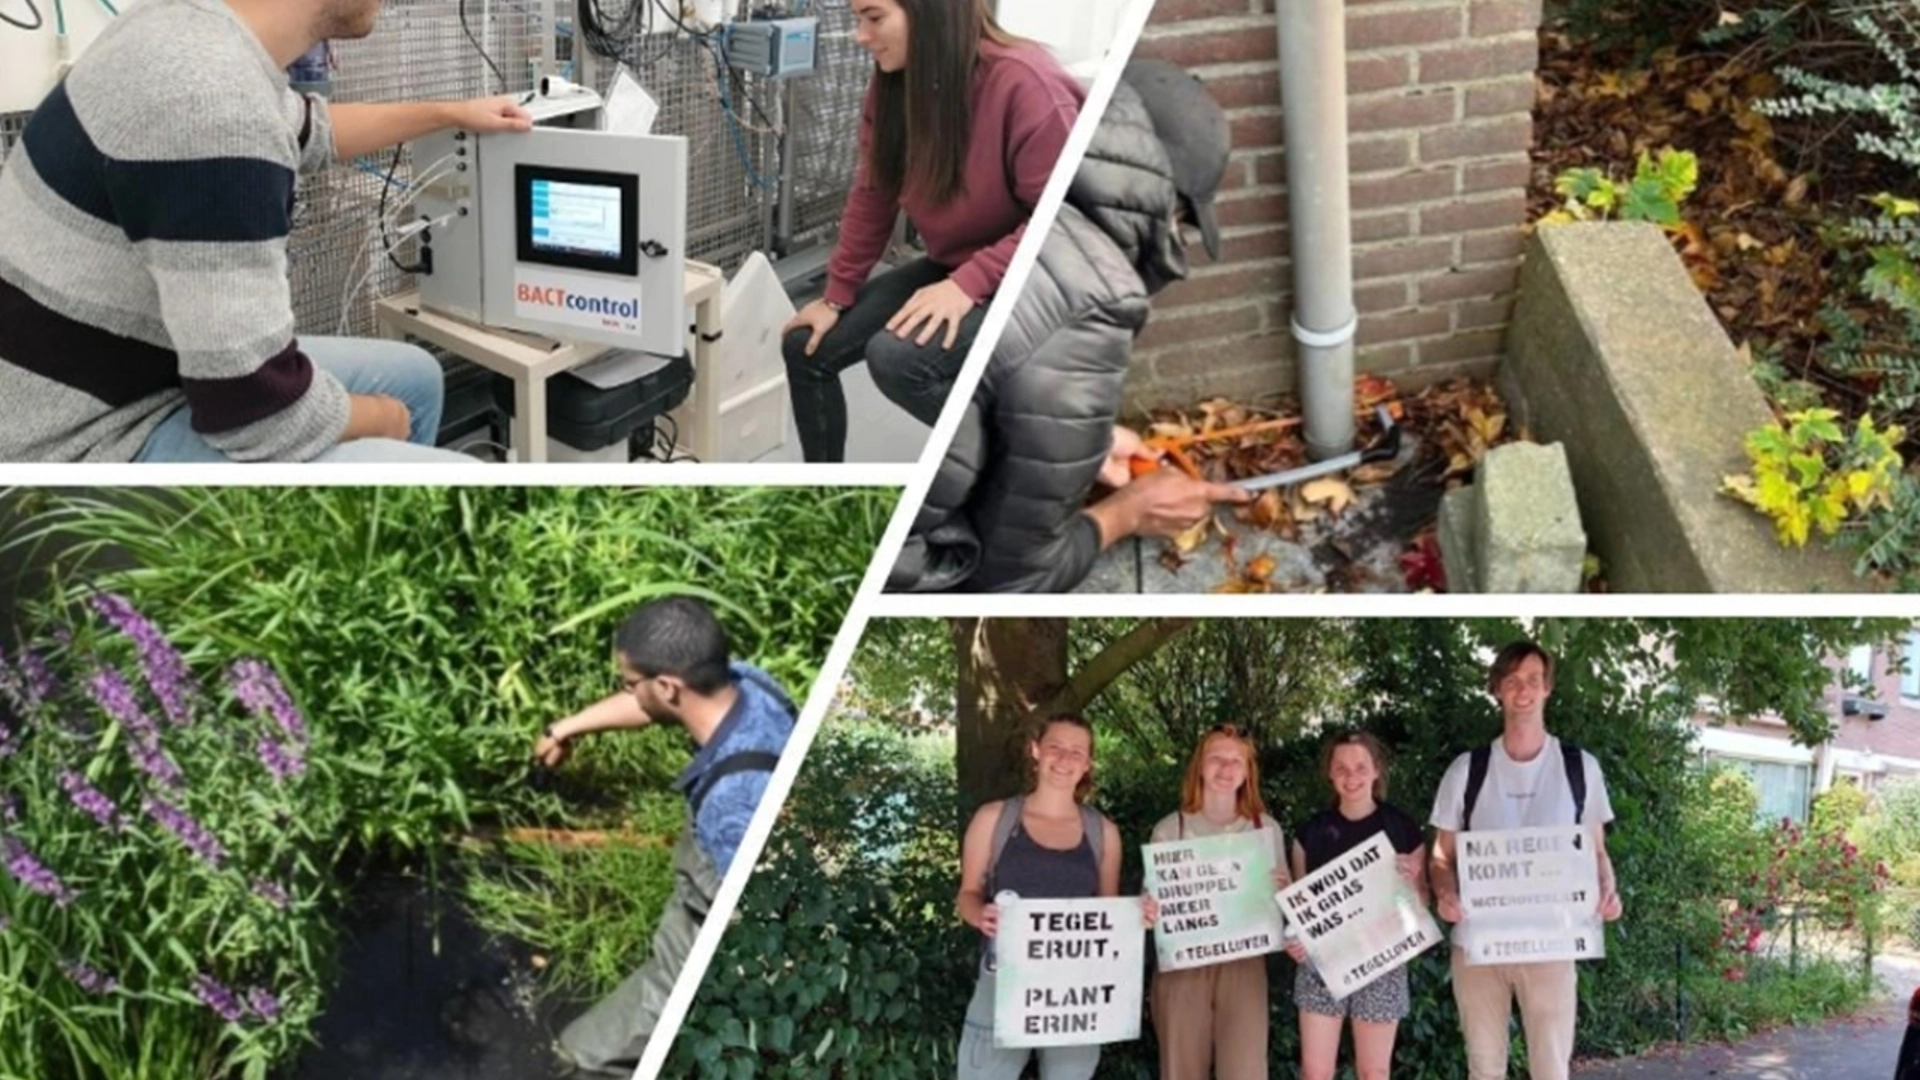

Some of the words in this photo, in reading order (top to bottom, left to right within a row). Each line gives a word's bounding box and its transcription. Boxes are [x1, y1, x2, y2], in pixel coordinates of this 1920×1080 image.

[517, 283, 638, 319] BACTcontrol
[1153, 849, 1195, 865] HIER
[1466, 840, 1498, 857] NA
[1287, 891, 1308, 909] IK
[1308, 866, 1348, 896] WOU
[1350, 845, 1382, 873] DAT
[1468, 860, 1534, 881] KOMT
[1158, 878, 1238, 899] DRUPPEL
[1161, 899, 1211, 917] MEER
[1296, 907, 1317, 925] IK
[1317, 878, 1364, 913] GRAS
[1029, 912, 1114, 932] TEGEL
[1163, 914, 1219, 934] LANGS
[1306, 912, 1343, 940] WAS
[1027, 939, 1119, 960] ERUIT,
[1025, 985, 1115, 1007] PLANT
[1024, 1013, 1097, 1034] ERIN!
